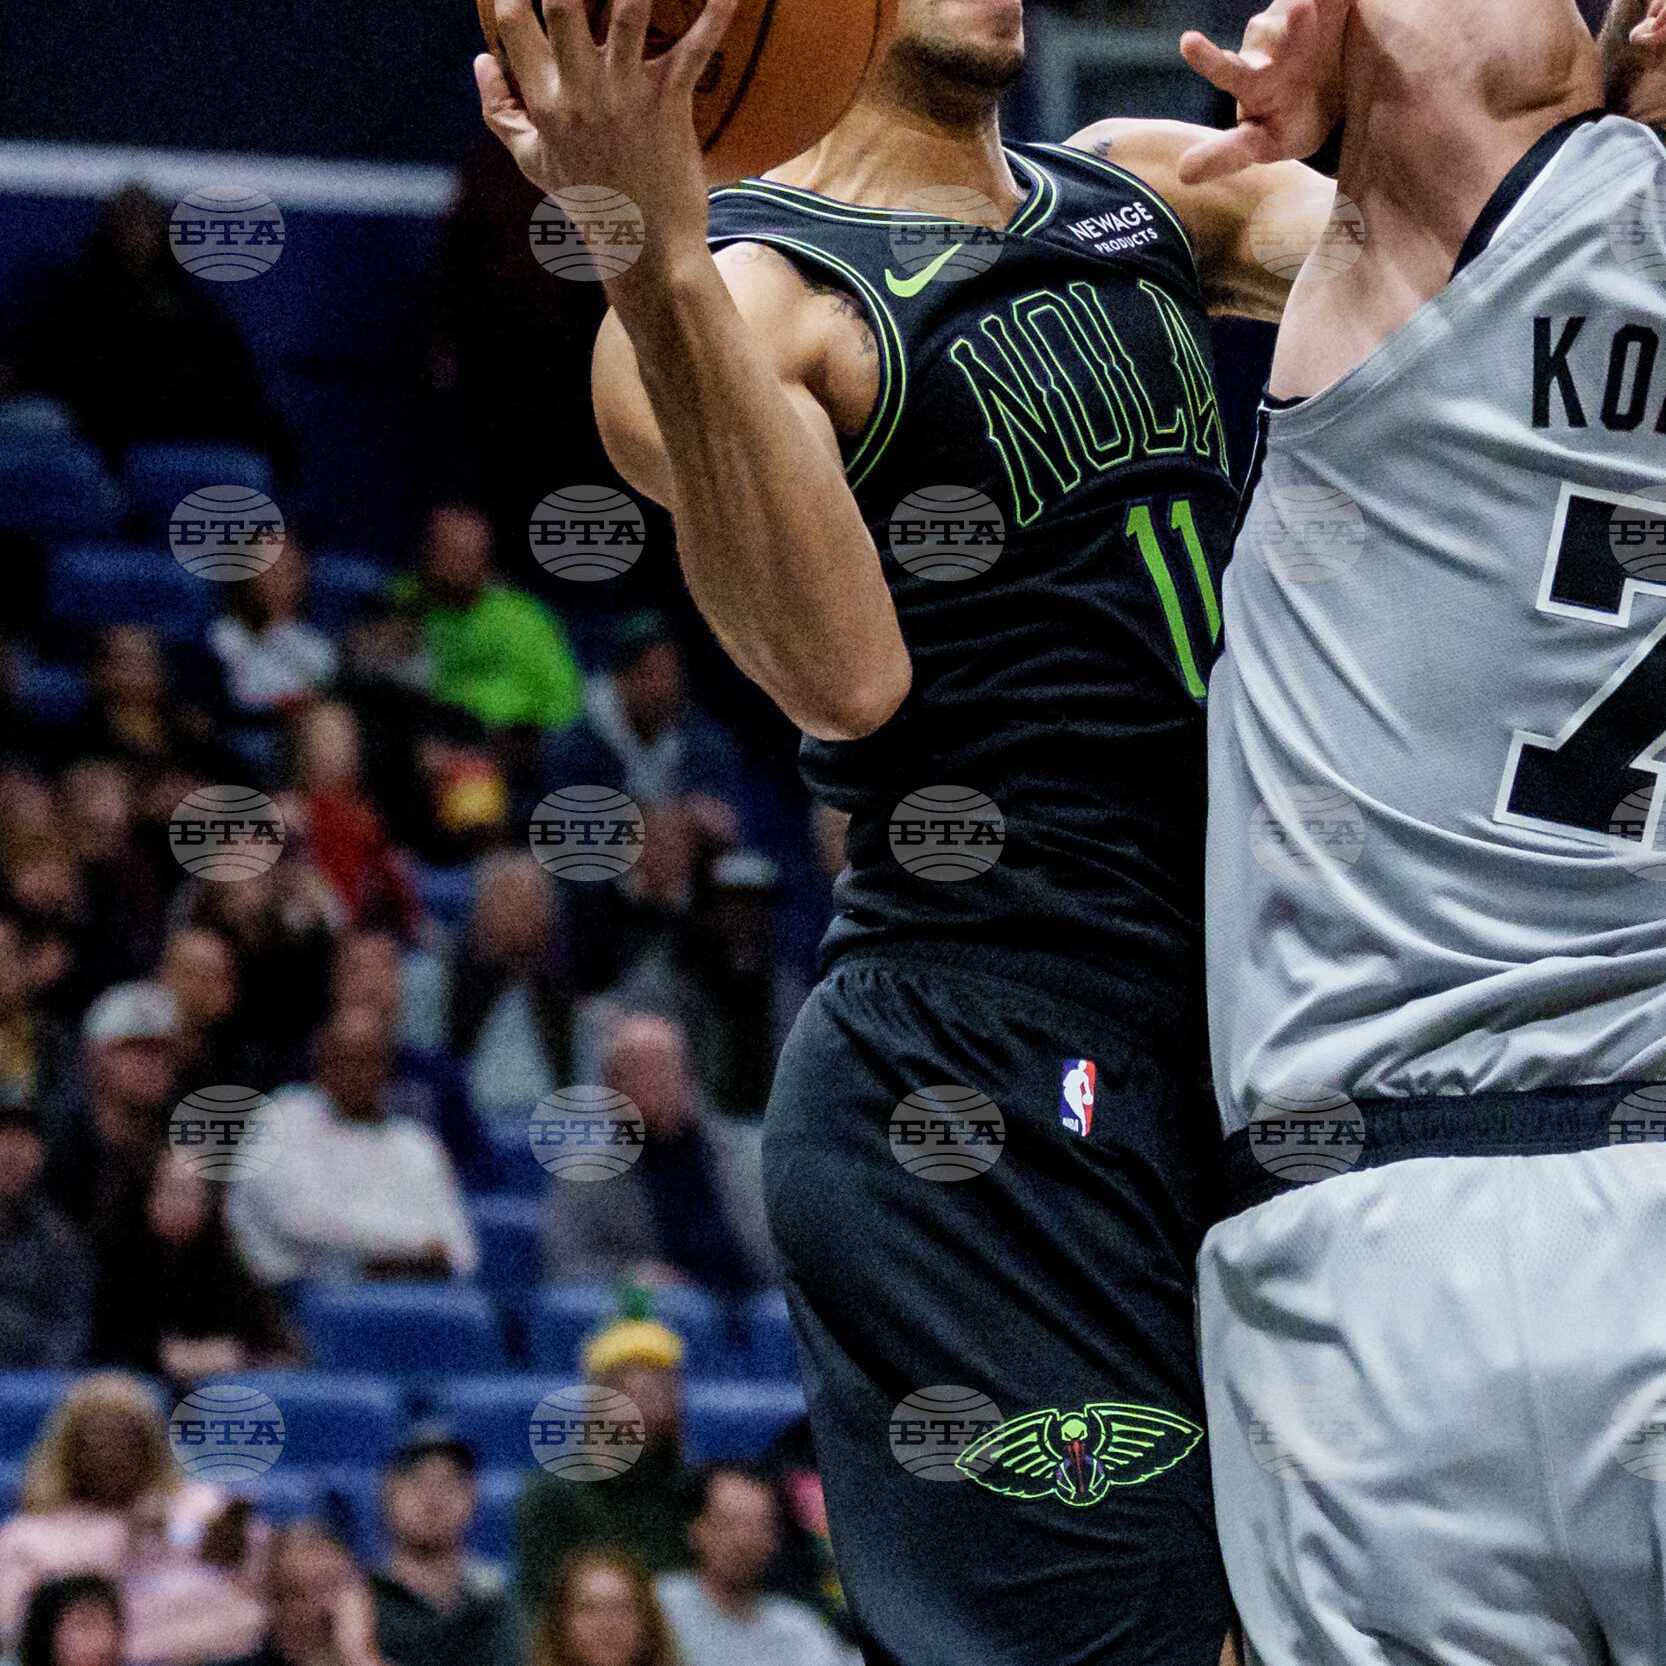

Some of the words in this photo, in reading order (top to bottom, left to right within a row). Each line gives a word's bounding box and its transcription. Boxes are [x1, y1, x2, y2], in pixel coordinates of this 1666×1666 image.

[1066, 201, 1154, 241] NEWAGE
[1094, 227, 1158, 253] PRODUCTS
[949, 279, 1230, 527] NOLA
[1125, 498, 1223, 699] 11
